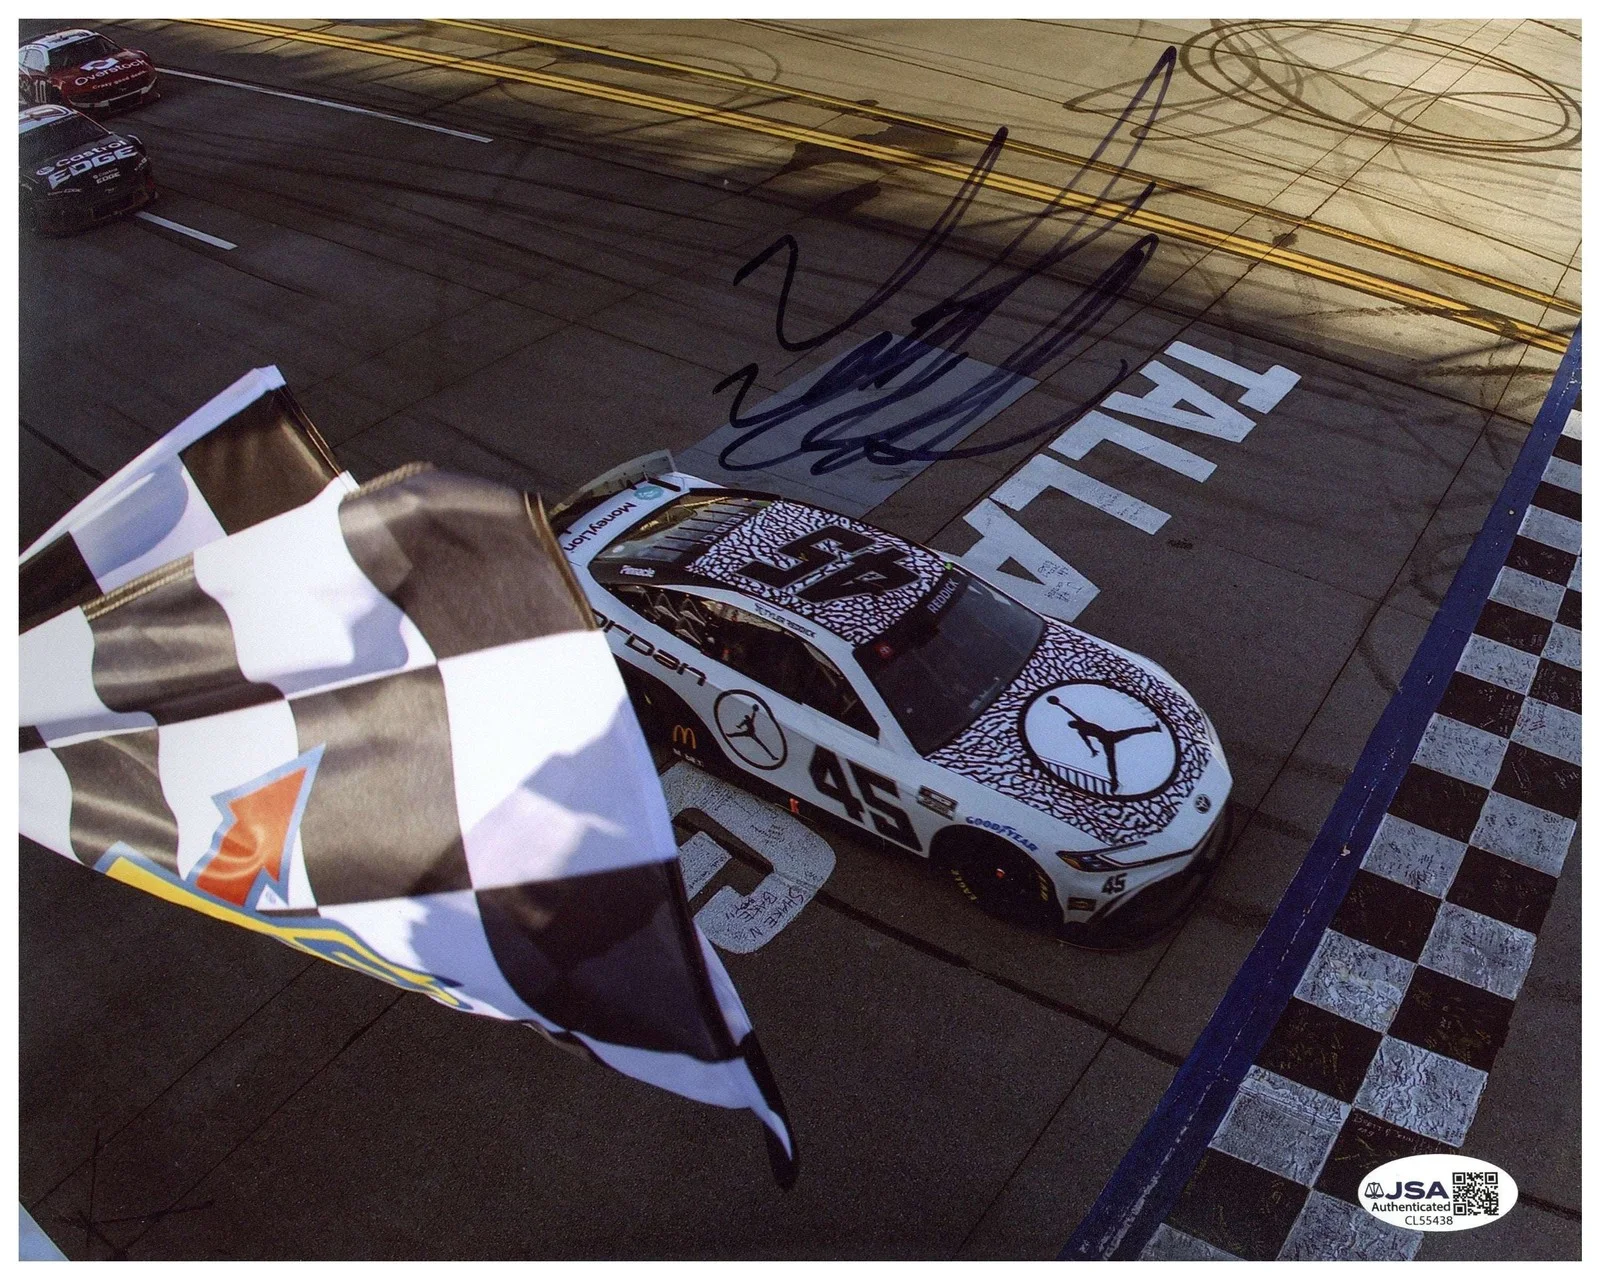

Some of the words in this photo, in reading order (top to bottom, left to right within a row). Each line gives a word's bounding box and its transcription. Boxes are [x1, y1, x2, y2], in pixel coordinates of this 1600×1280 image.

[75, 60, 146, 86] Overstock
[47, 145, 138, 190] EDGE
[56, 140, 127, 167] Castrol
[563, 502, 637, 553] MoneyLion
[927, 578, 960, 614] REDDICK
[808, 744, 923, 852] 45
[965, 816, 1039, 852] GOODYEAR
[1101, 872, 1128, 895] 45
[737, 891, 778, 923] BAKE
[763, 886, 805, 929] SHAKE
